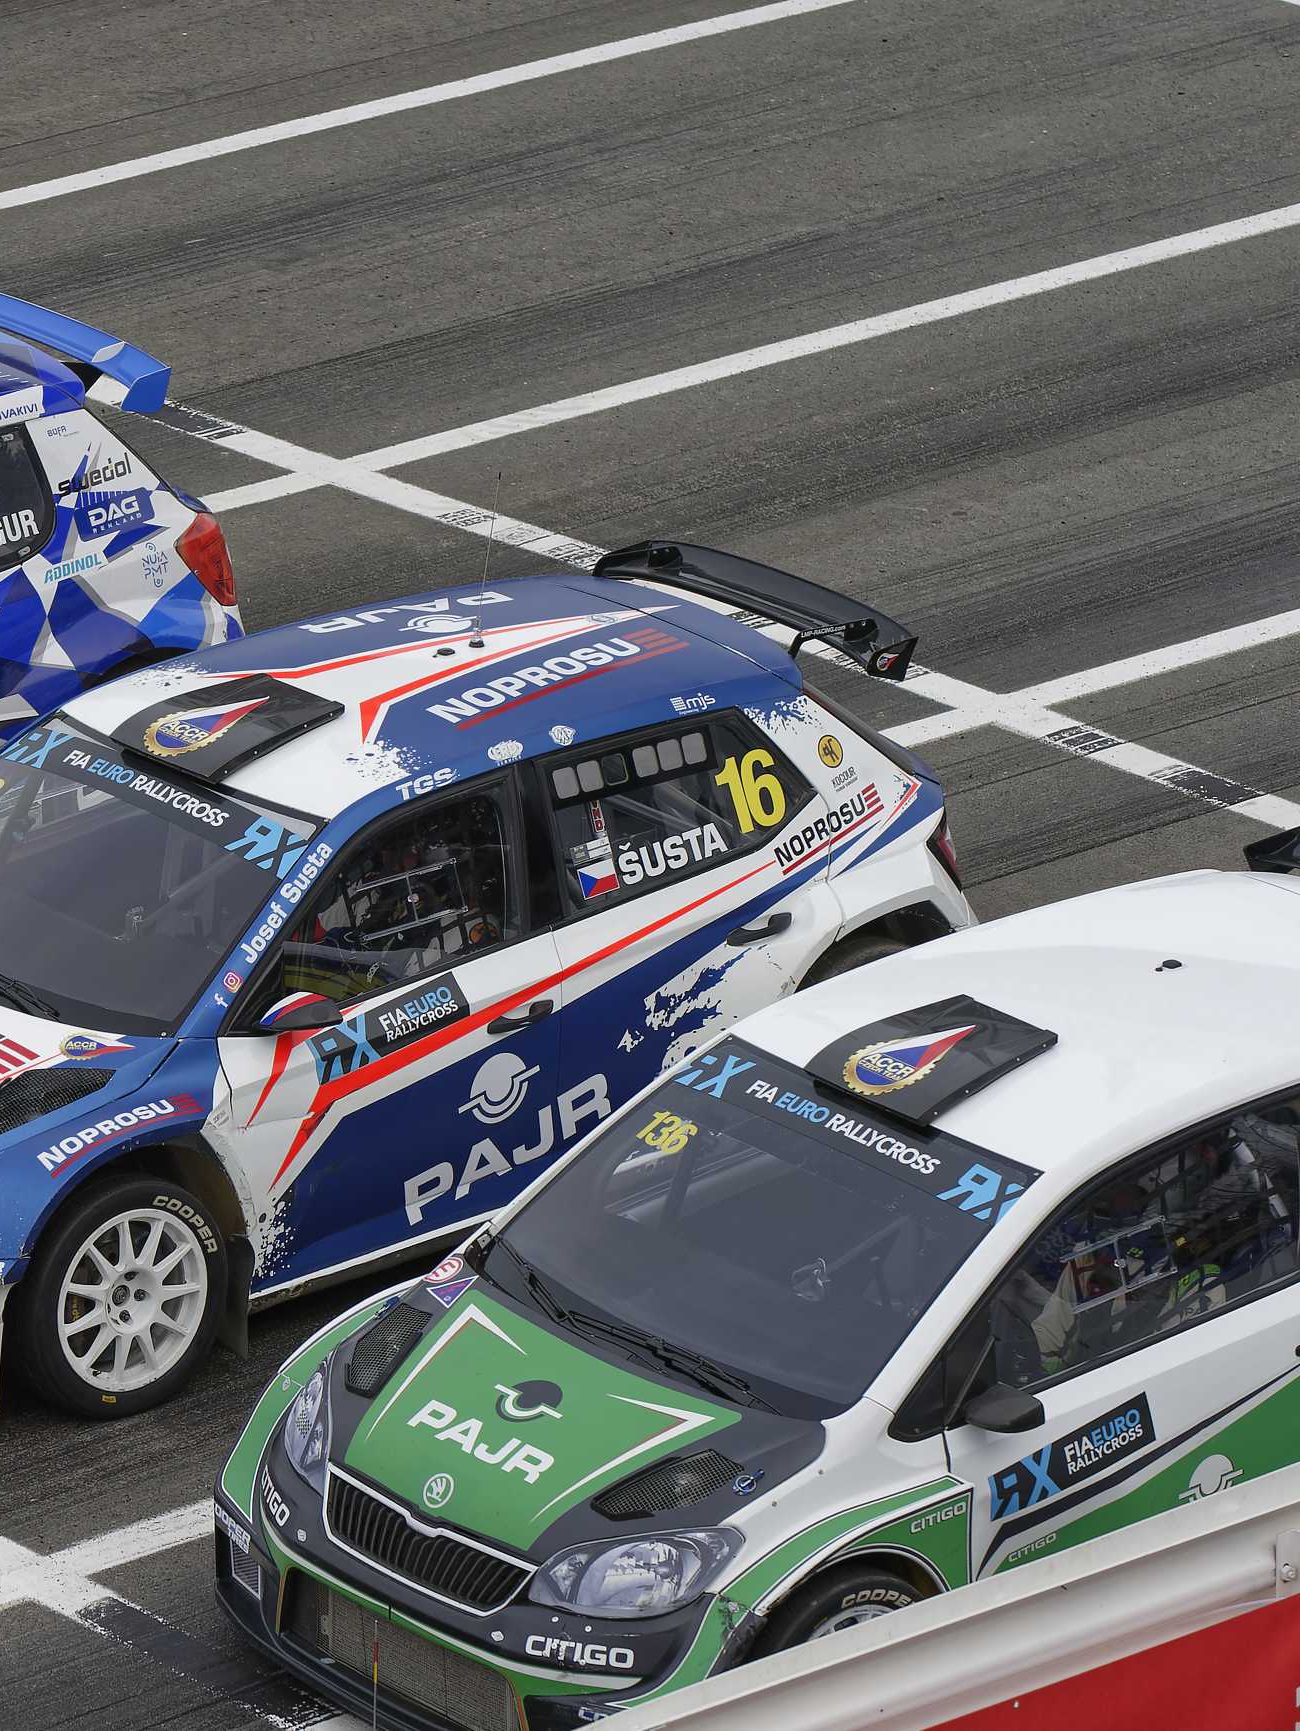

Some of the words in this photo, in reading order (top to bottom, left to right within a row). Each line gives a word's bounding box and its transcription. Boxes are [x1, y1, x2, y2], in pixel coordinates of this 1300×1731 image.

[57, 452, 132, 497] swedol
[88, 495, 140, 527] DAG
[44, 553, 102, 585] ADDINOL
[298, 591, 515, 634] PAJR
[425, 637, 641, 724] NOPROSU
[685, 692, 716, 710] mjs
[63, 749, 93, 770] FIA
[86, 757, 136, 785] EURO
[129, 774, 230, 828] RALLYCROSS
[714, 748, 786, 834] 16
[831, 766, 856, 788] KOCOUR
[774, 793, 867, 867] NOPROSU
[617, 822, 729, 887] ŠUSTA
[240, 901, 288, 964] Josef
[280, 842, 333, 904] Susta
[386, 1000, 459, 1043] RALLYCROSS
[863, 1053, 916, 1080] ACCR
[36, 1098, 175, 1172] NOPROSU
[403, 1073, 612, 1227] PAJR
[636, 1109, 698, 1155] 136
[745, 1079, 779, 1104] FIA
[773, 1091, 830, 1124] EURO
[824, 1113, 942, 1176] RALLYCROSS
[152, 1195, 219, 1255] COOPER
[406, 1399, 555, 1485] PAJR
[1067, 1424, 1143, 1475] RALLYCROSS
[910, 1501, 967, 1533] CITIGO
[1008, 1532, 1057, 1562] CITIGO
[841, 1588, 913, 1609] COOPE
[525, 1634, 635, 1669] CITIGO
